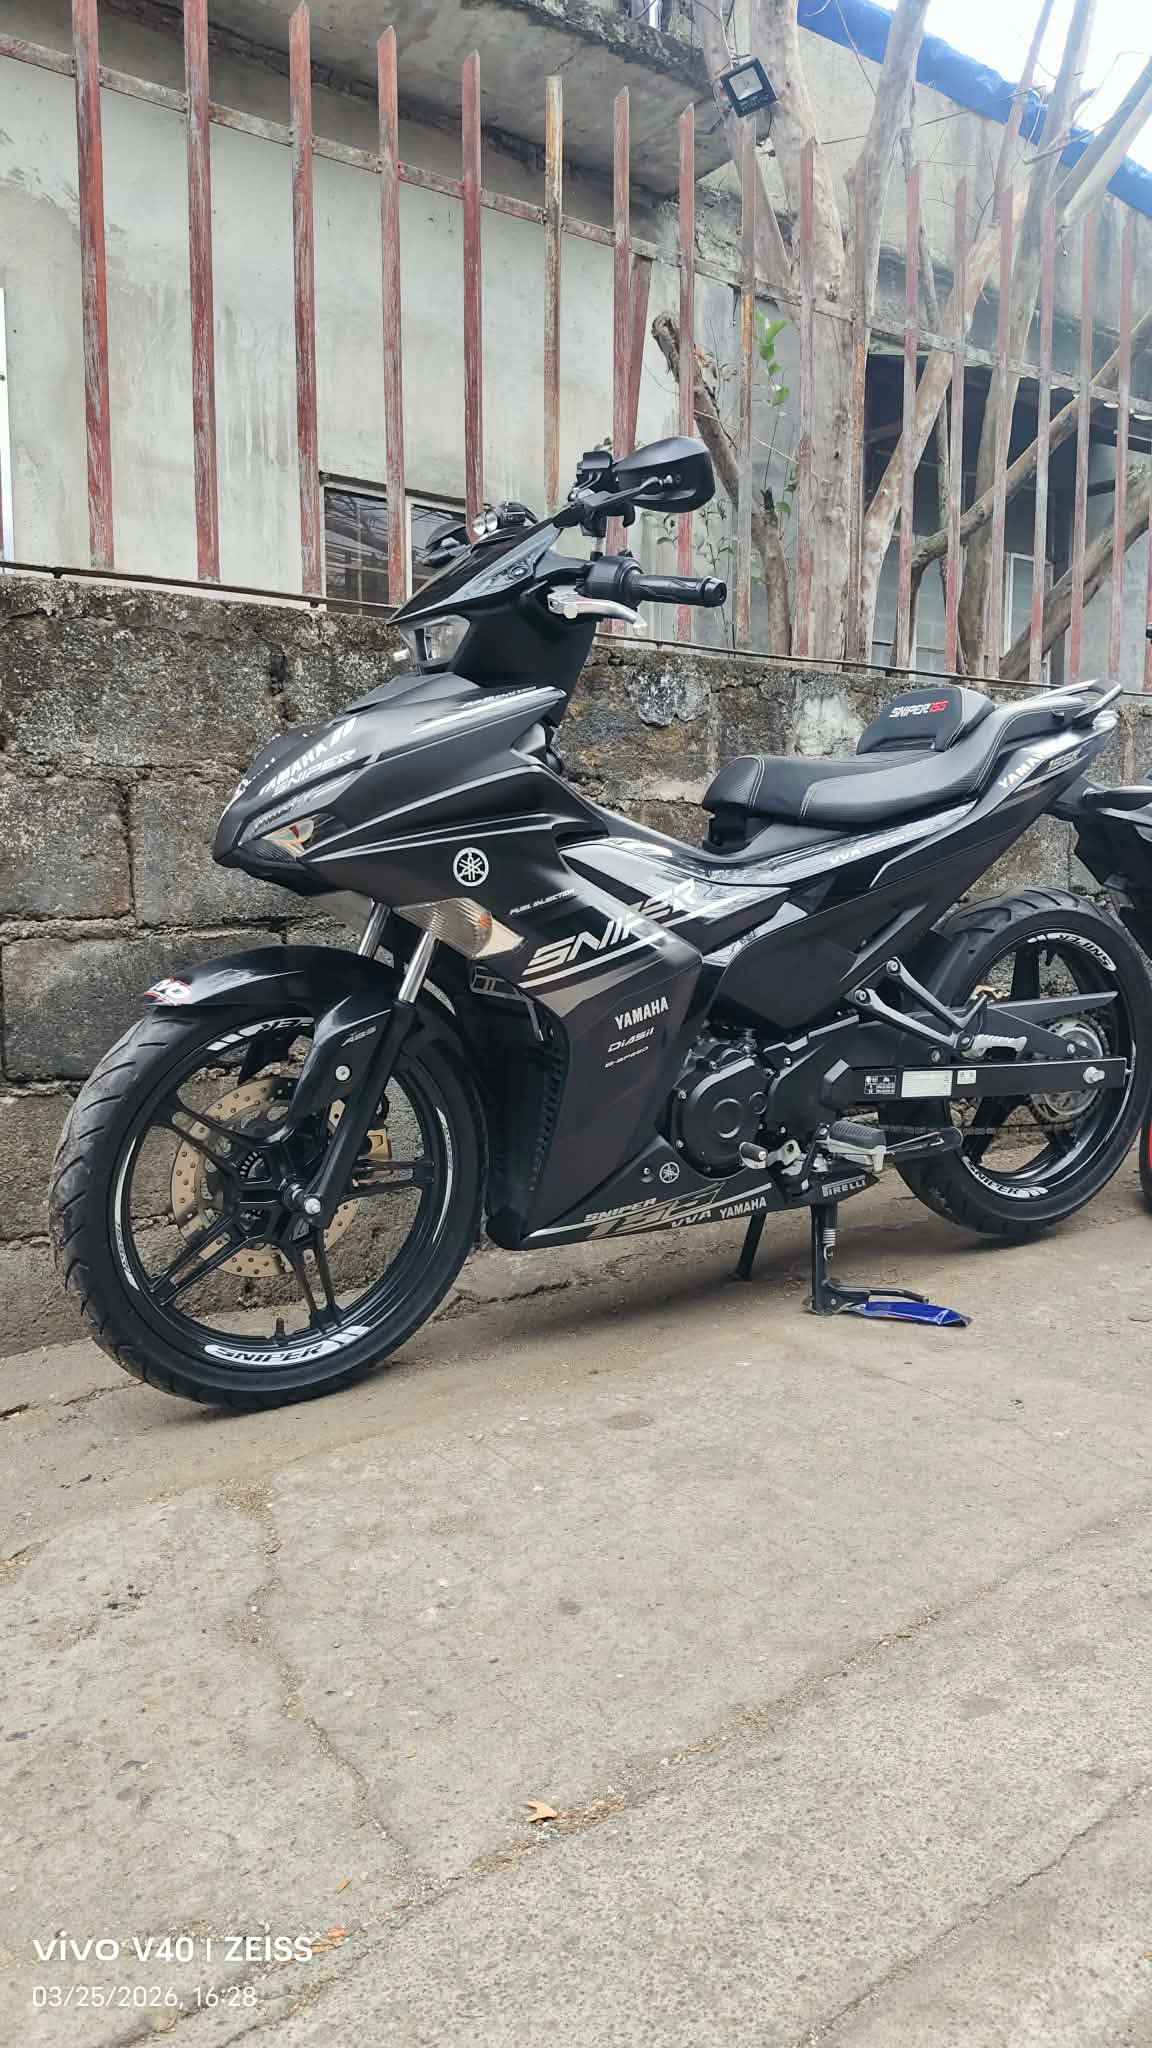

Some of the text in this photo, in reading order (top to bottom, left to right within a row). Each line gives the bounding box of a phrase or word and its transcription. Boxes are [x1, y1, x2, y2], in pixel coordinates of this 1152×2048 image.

[614, 996, 670, 1030] YAMAHA
[822, 1175, 866, 1197] PIRELLI
[584, 1197, 657, 1223] SNIPER
[671, 1197, 767, 1228] VVA YAMAHA
[215, 1343, 322, 1362] SNIPER
